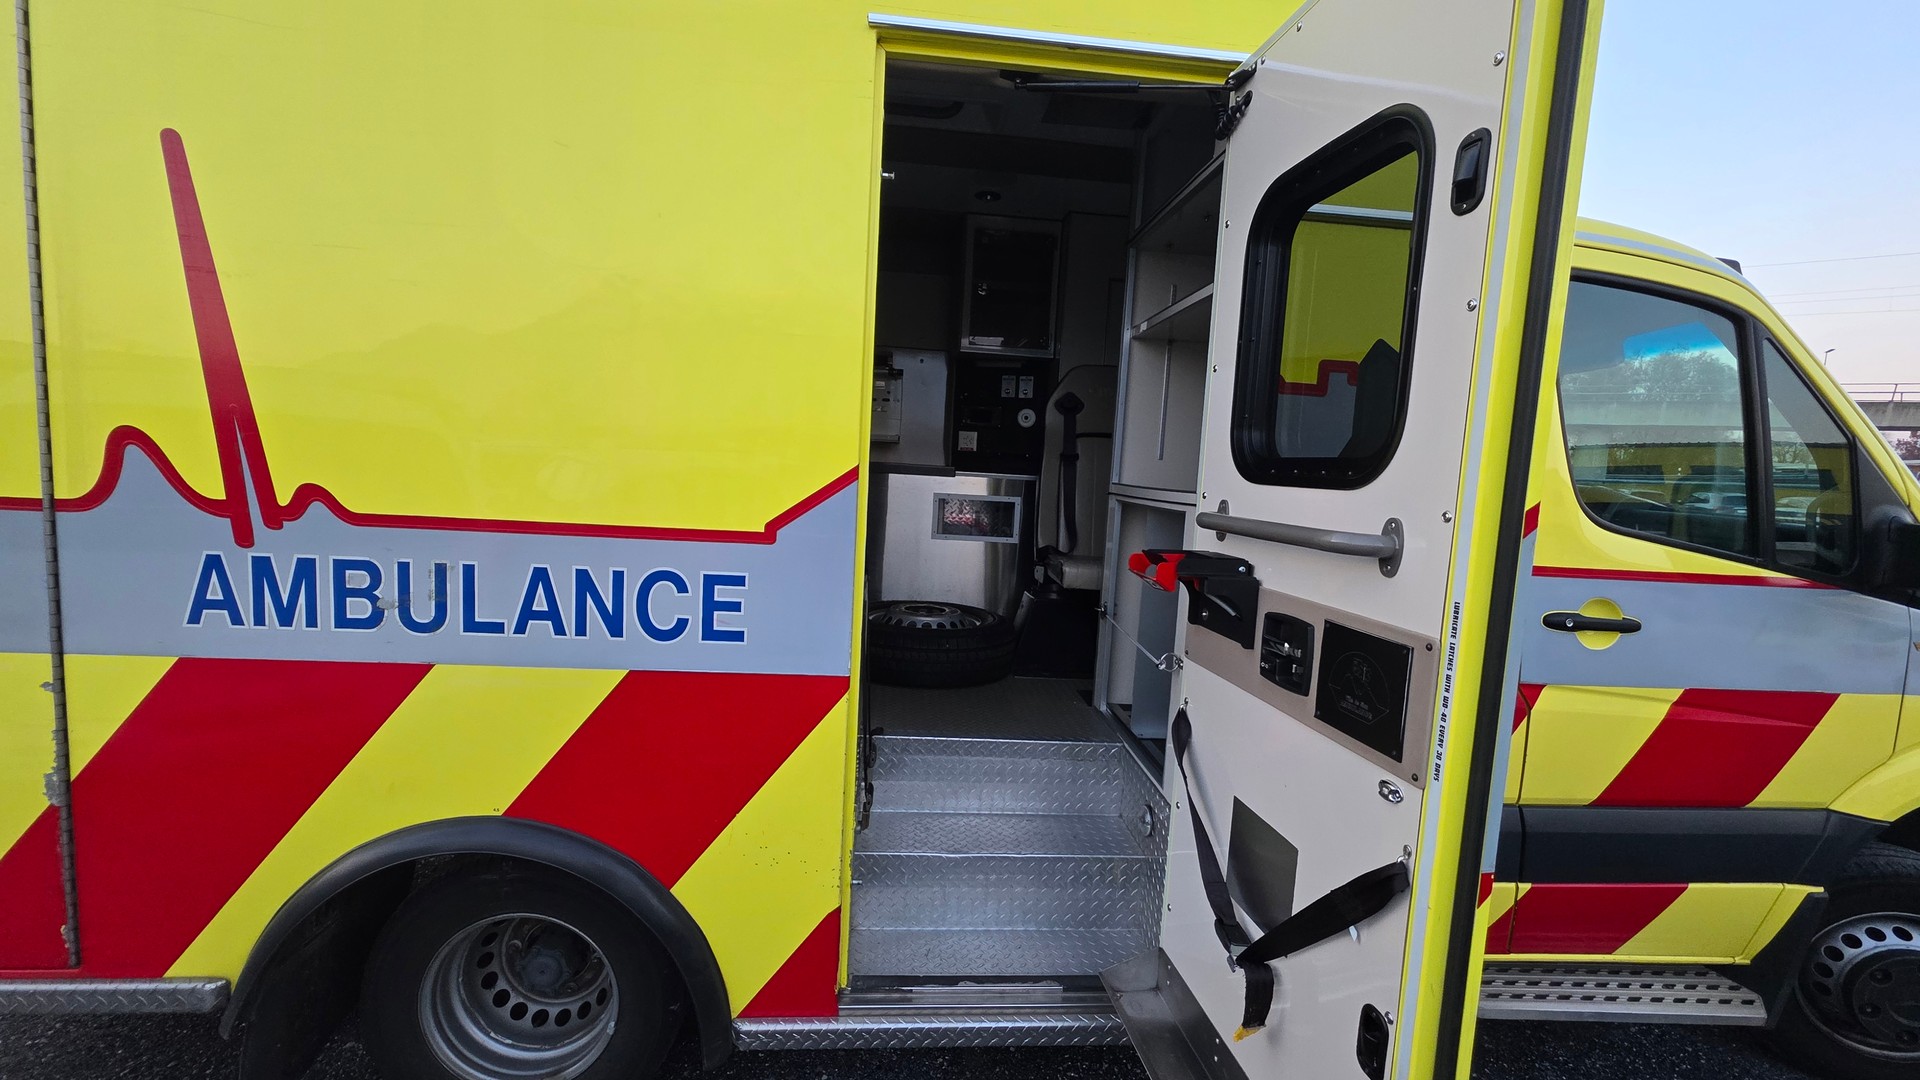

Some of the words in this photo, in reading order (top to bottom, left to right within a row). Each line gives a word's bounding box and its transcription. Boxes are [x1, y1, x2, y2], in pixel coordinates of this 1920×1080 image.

[184, 551, 748, 644] AMBULANCE
[1450, 601, 1460, 639] LUBRICATE
[1446, 642, 1456, 671] LATCHES
[1443, 674, 1452, 693] WITH
[1440, 696, 1449, 723] WD-40
[1437, 725, 1446, 749] EVERY
[1435, 750, 1443, 761] 30
[1433, 763, 1441, 782] DAYS
